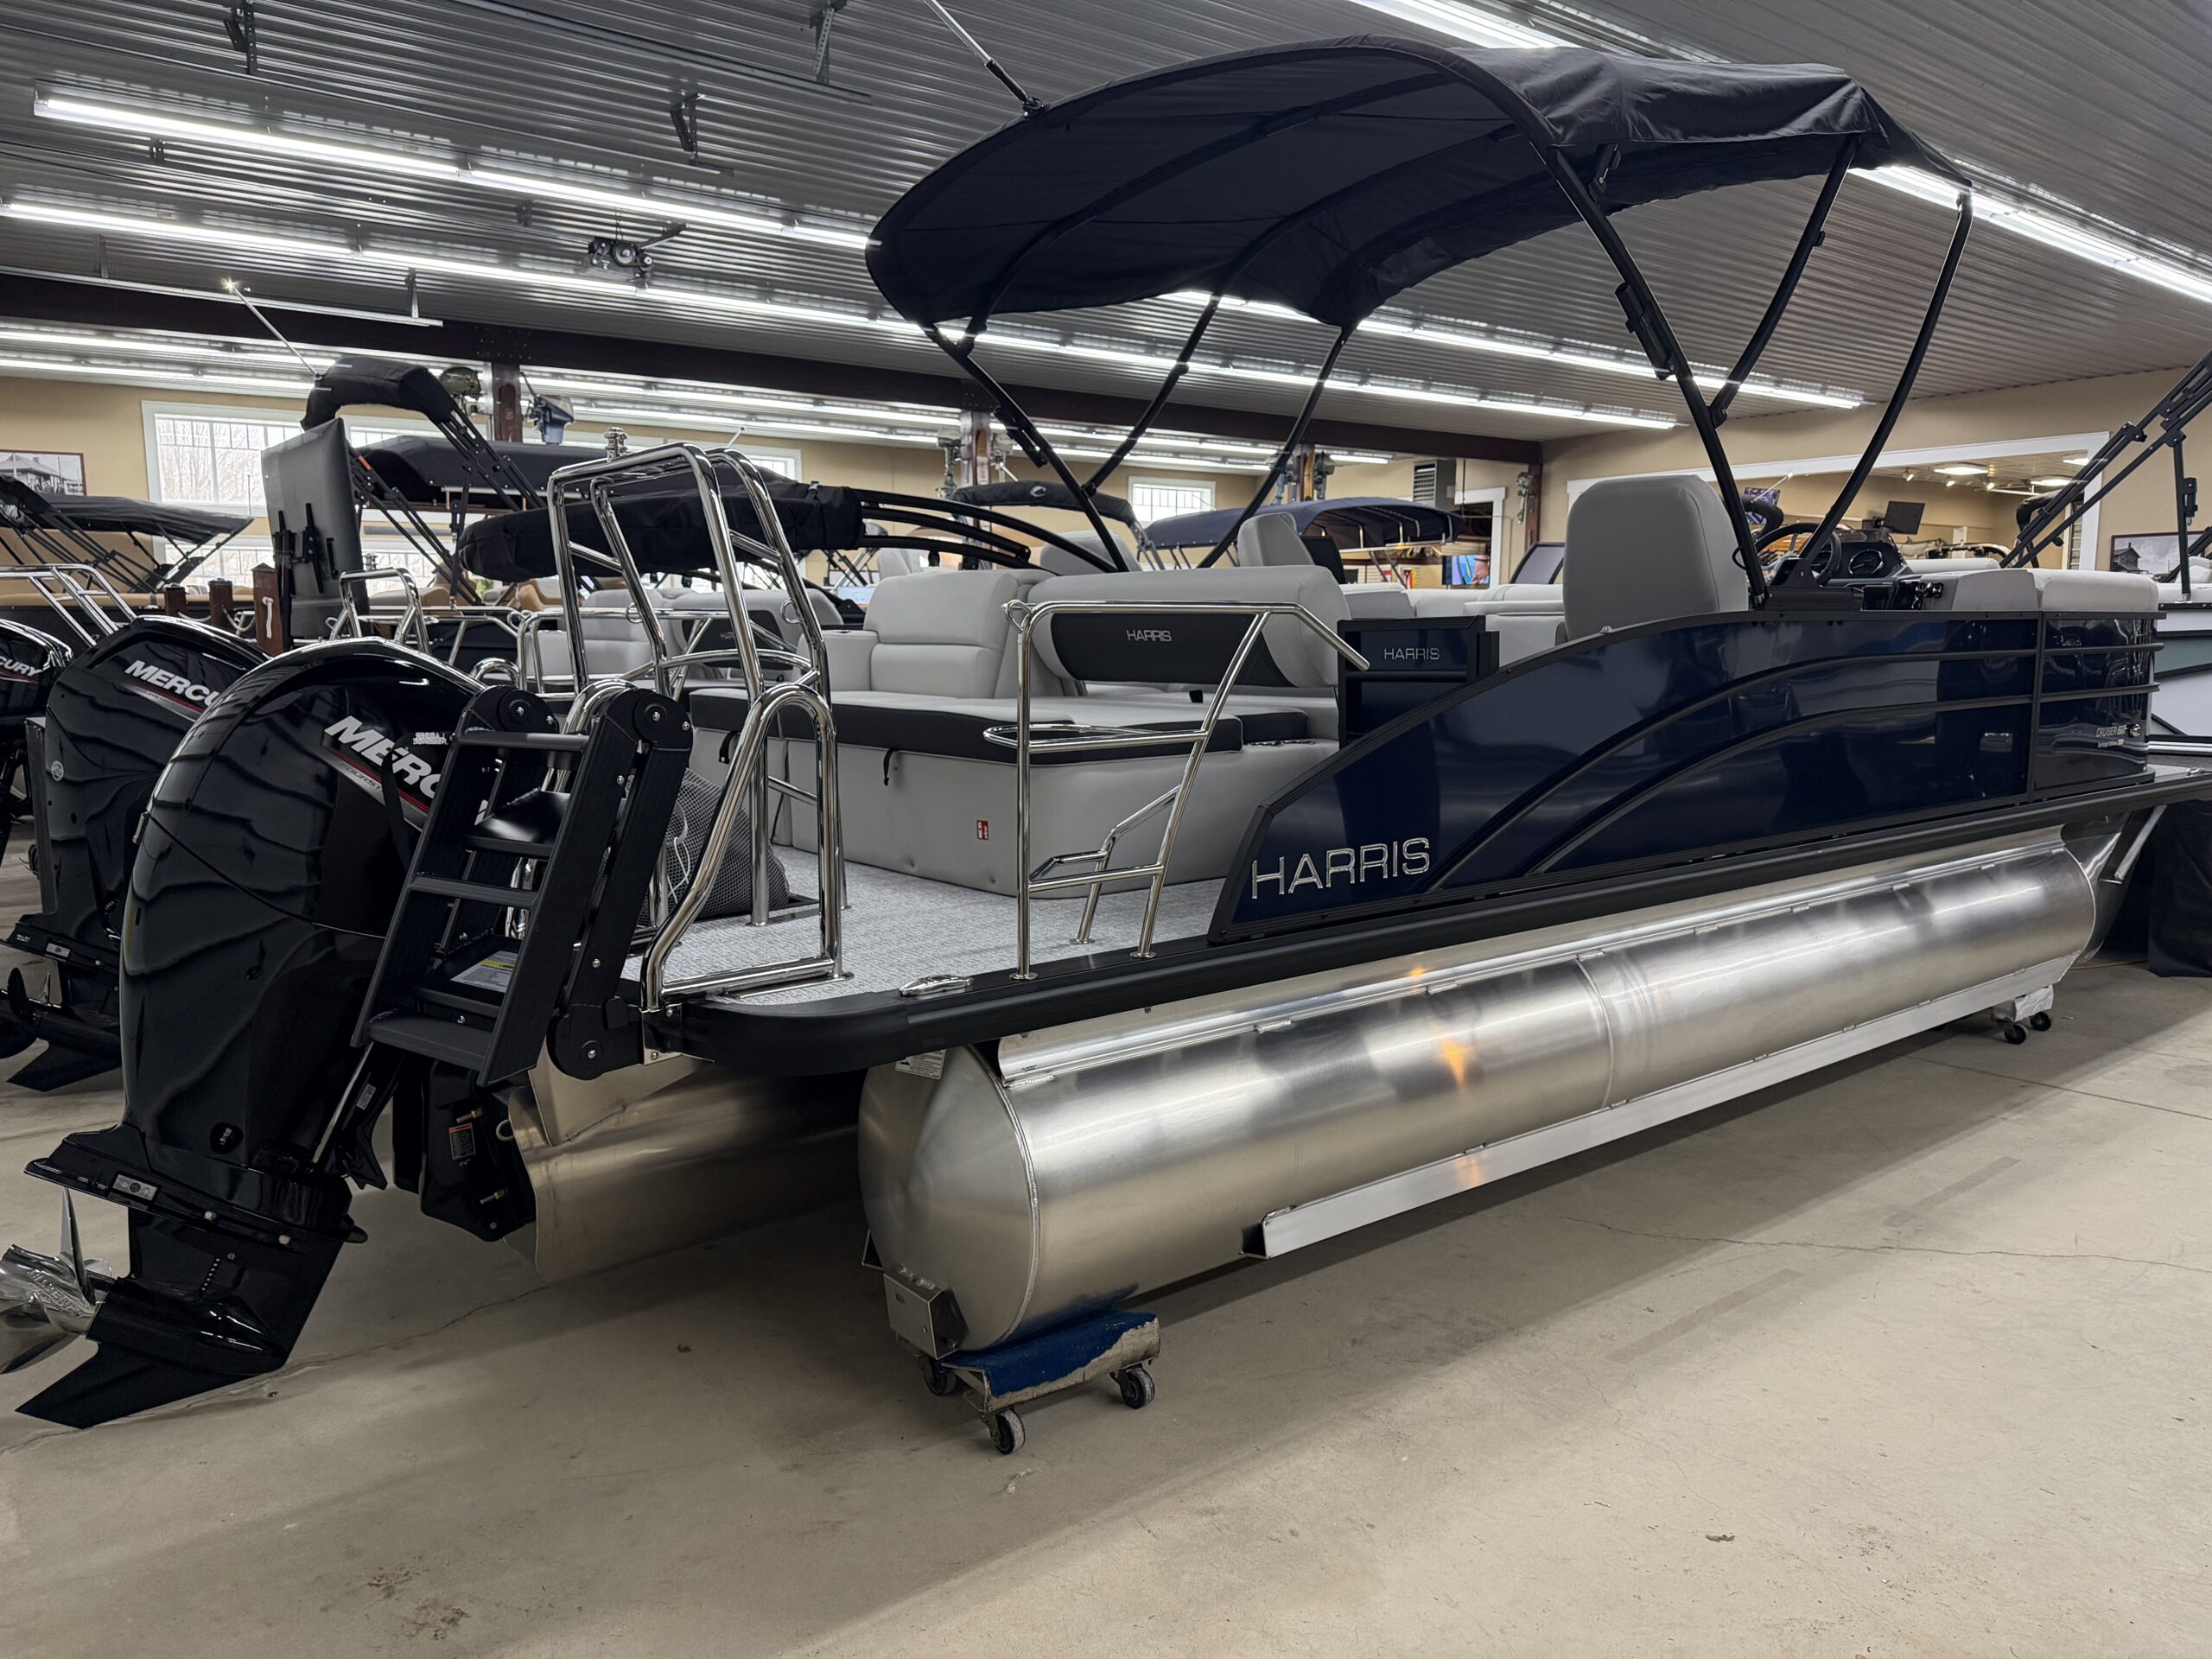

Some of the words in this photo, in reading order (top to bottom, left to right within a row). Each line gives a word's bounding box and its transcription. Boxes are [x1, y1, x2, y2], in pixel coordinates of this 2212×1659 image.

[1126, 629, 1173, 641] HARRIS
[1384, 648, 1440, 660] HARRIS
[124, 659, 219, 707] MERC
[324, 715, 443, 799] MERC
[1252, 837, 1430, 899] HARRIS
